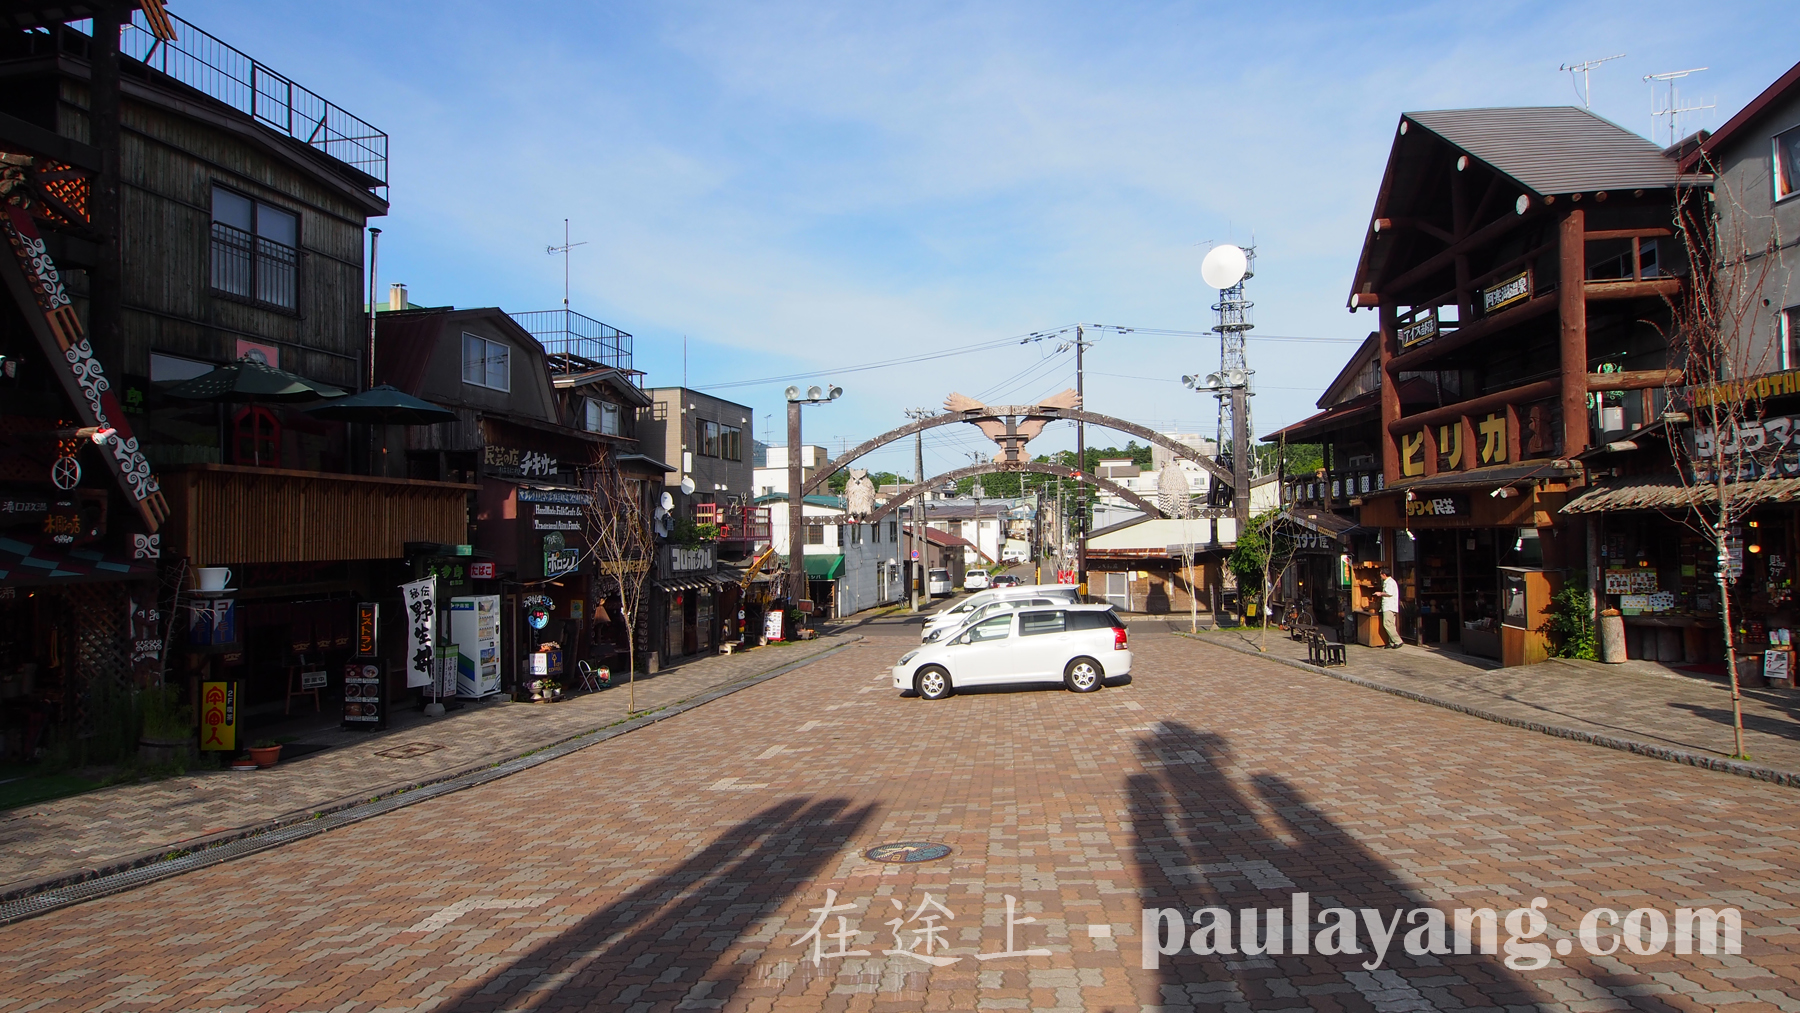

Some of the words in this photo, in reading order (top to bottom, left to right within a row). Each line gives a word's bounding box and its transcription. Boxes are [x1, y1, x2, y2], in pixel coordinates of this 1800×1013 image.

[1485, 276, 1529, 309] 阿寒湖温泉
[484, 445, 520, 467] 民芸の店
[520, 450, 558, 477] チキサニ
[1401, 413, 1507, 477] ピリカ
[471, 565, 492, 576] たばこ
[218, 602, 229, 642] コーヒー
